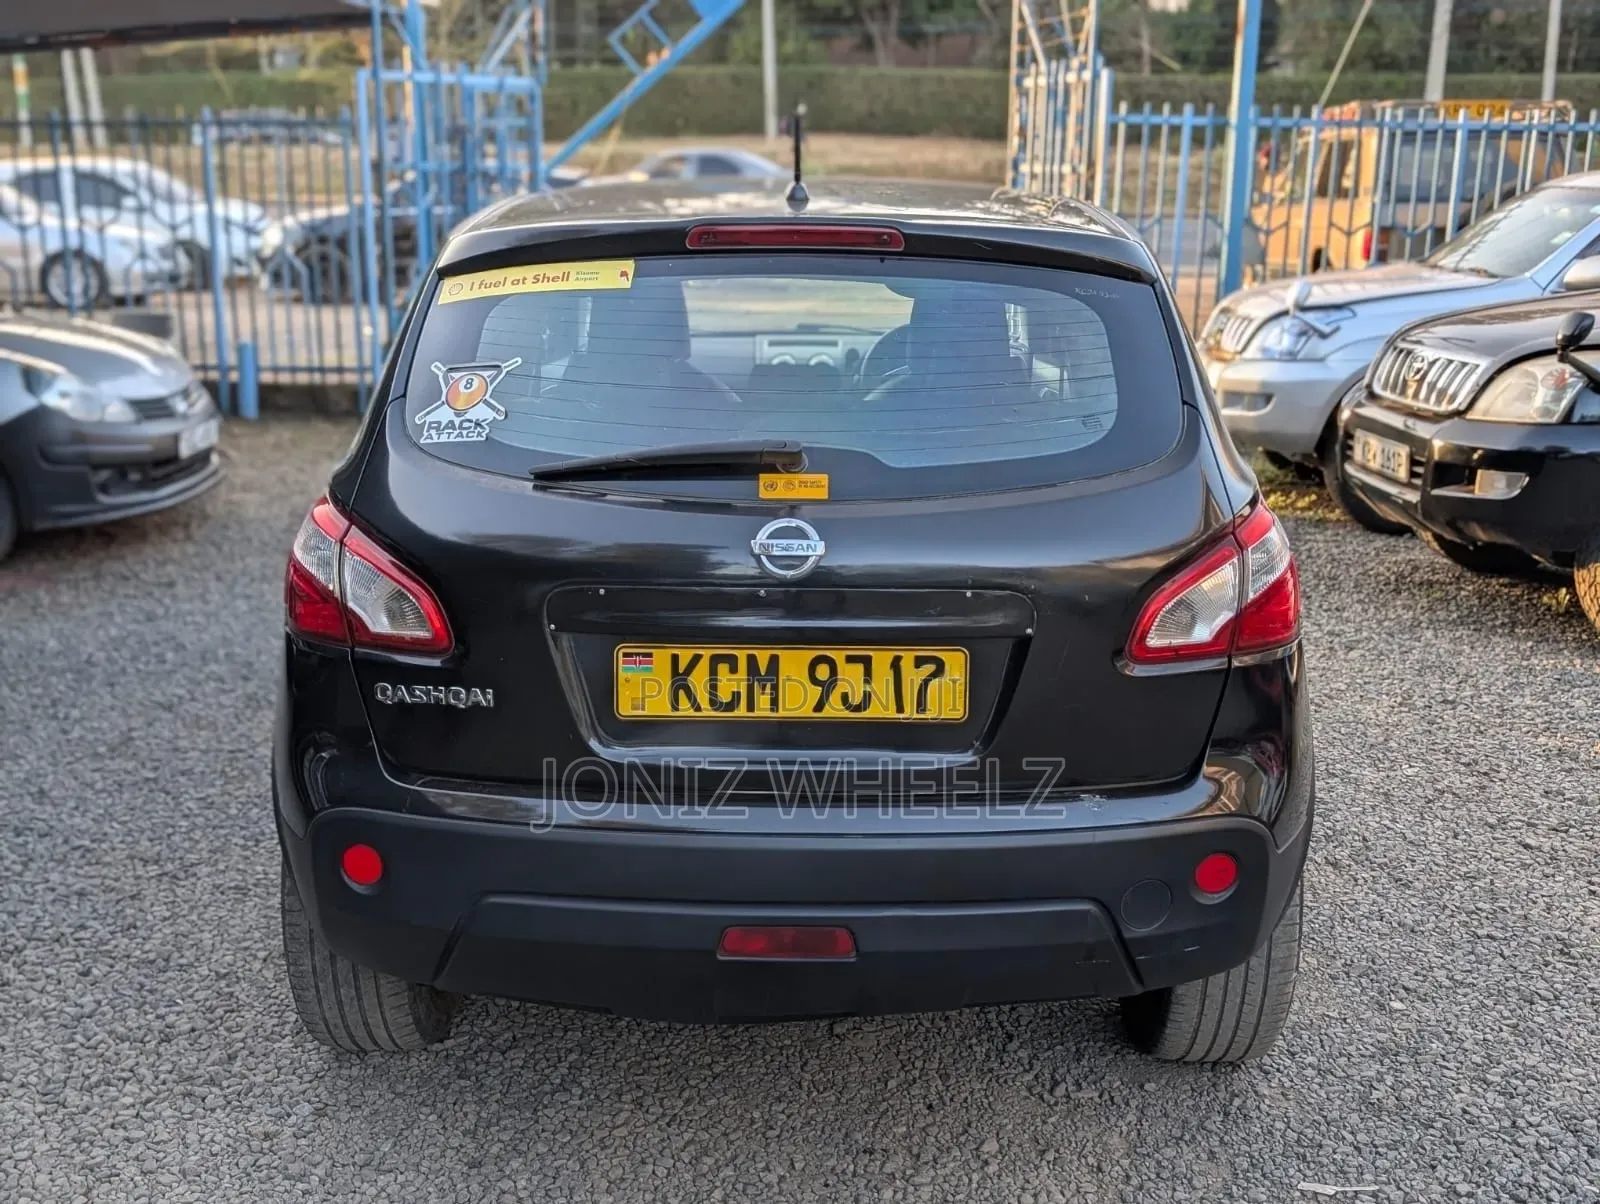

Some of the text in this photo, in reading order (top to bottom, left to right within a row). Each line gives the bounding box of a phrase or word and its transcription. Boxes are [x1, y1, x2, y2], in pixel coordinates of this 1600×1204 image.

[476, 276, 507, 291] fuel
[510, 276, 528, 287] at
[531, 271, 571, 285] Shell
[463, 377, 475, 390] 8
[425, 418, 490, 433] RACK
[422, 430, 486, 441] ATTACK
[758, 542, 818, 553] NISSAN
[670, 652, 780, 714] KCM
[373, 682, 494, 709] QASHQAI
